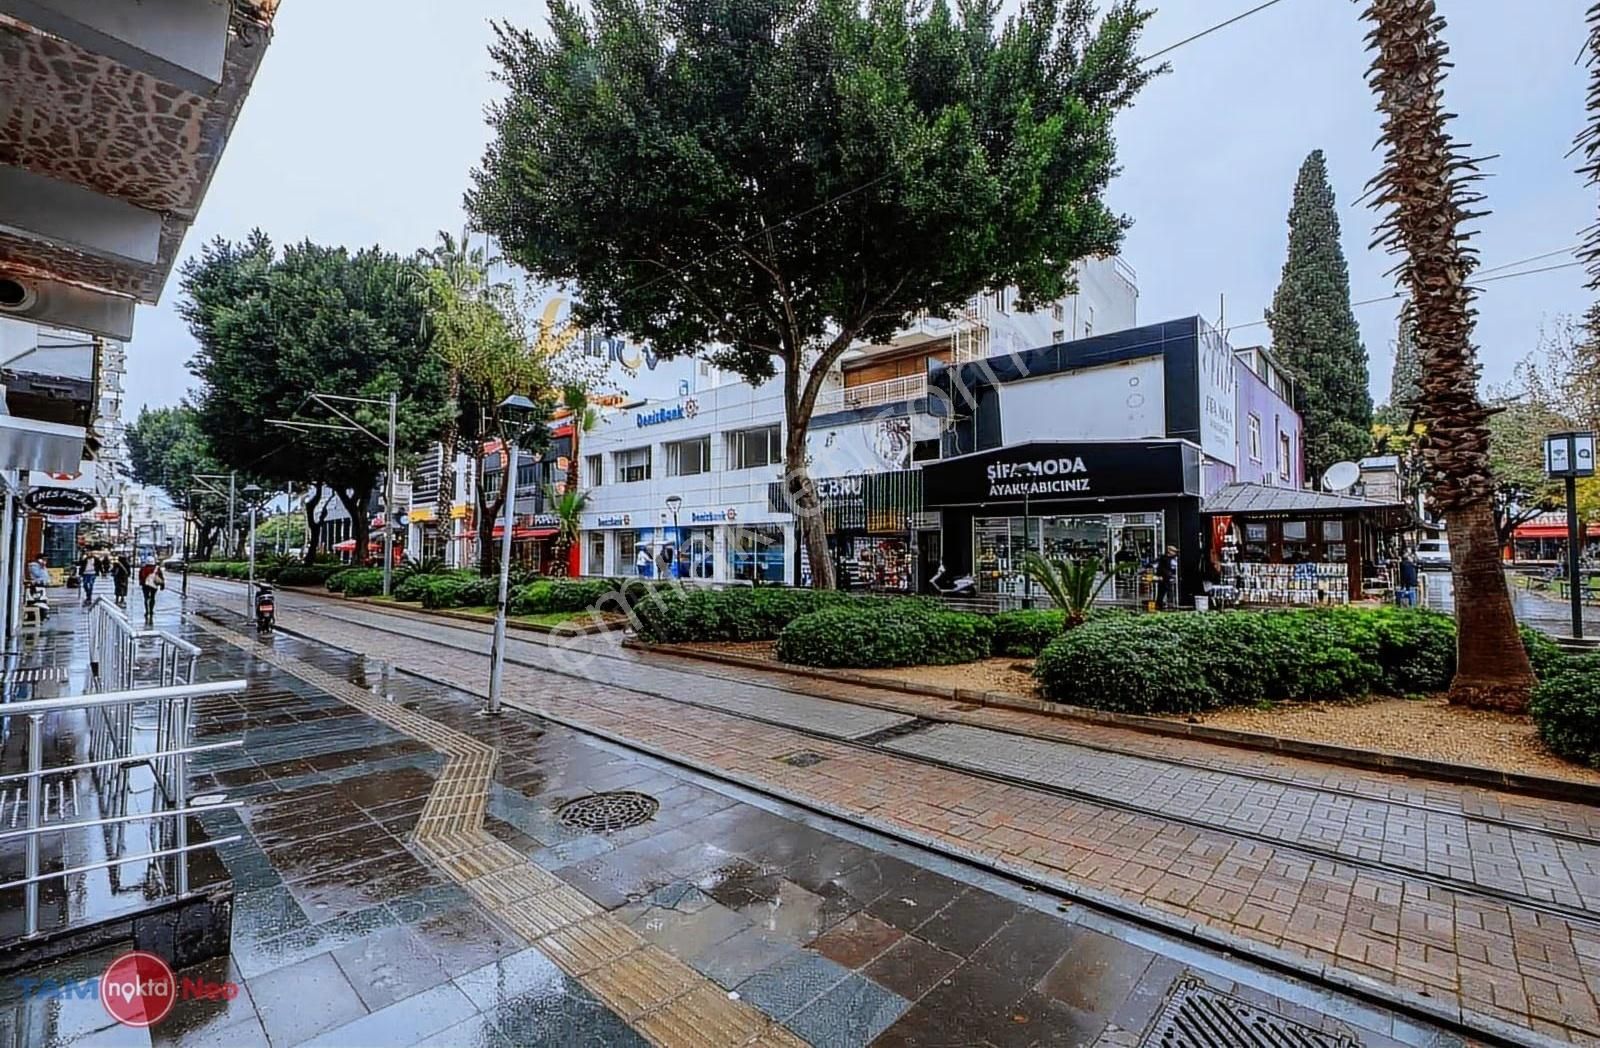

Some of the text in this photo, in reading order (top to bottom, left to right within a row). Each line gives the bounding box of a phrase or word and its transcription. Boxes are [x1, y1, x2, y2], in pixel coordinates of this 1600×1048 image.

[636, 403, 685, 428] DenizBank
[817, 477, 862, 498] EBRU
[989, 479, 1091, 496] AYAKKABICINIZ
